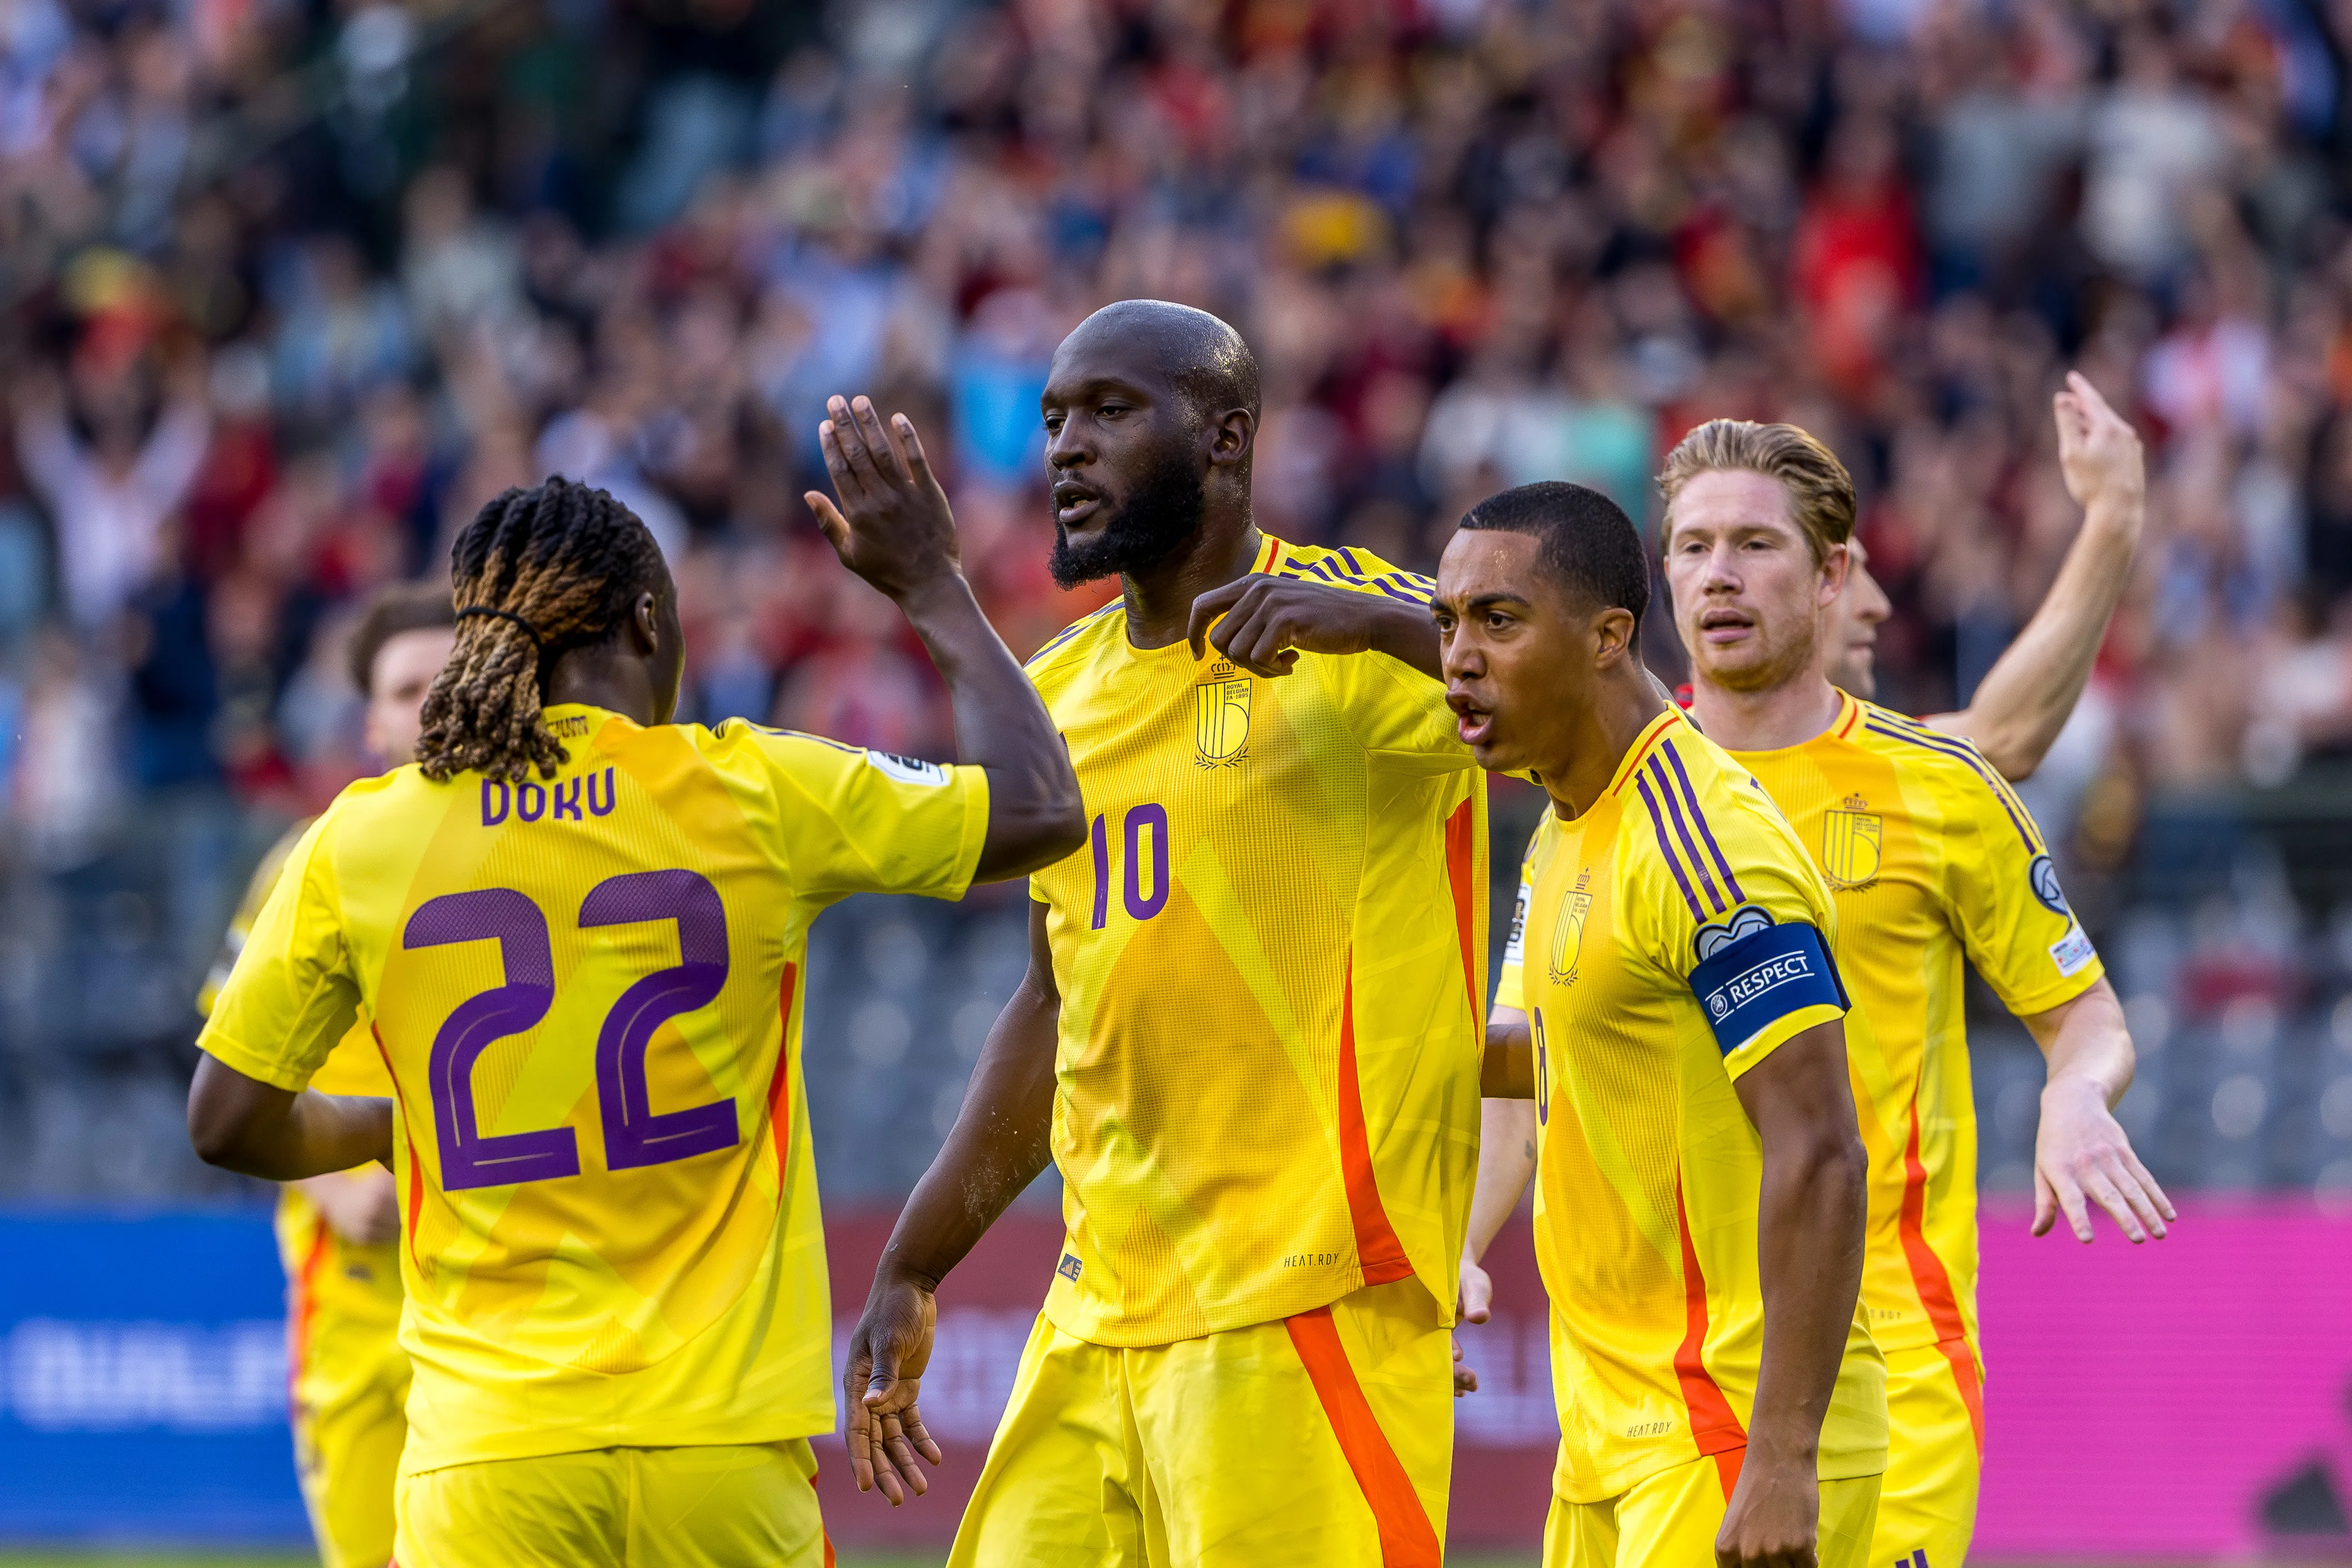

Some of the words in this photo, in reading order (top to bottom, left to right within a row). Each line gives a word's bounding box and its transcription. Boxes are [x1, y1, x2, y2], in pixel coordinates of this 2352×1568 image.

[1226, 687, 1249, 696] BELGIAN
[482, 766, 616, 827] DOKU
[1091, 802, 1169, 931] 10
[1730, 956, 1809, 1004] RESPECT
[403, 869, 740, 1192] 22
[1534, 1006, 1548, 1127] 8
[1284, 1252, 1339, 1268] HEAT.RDY
